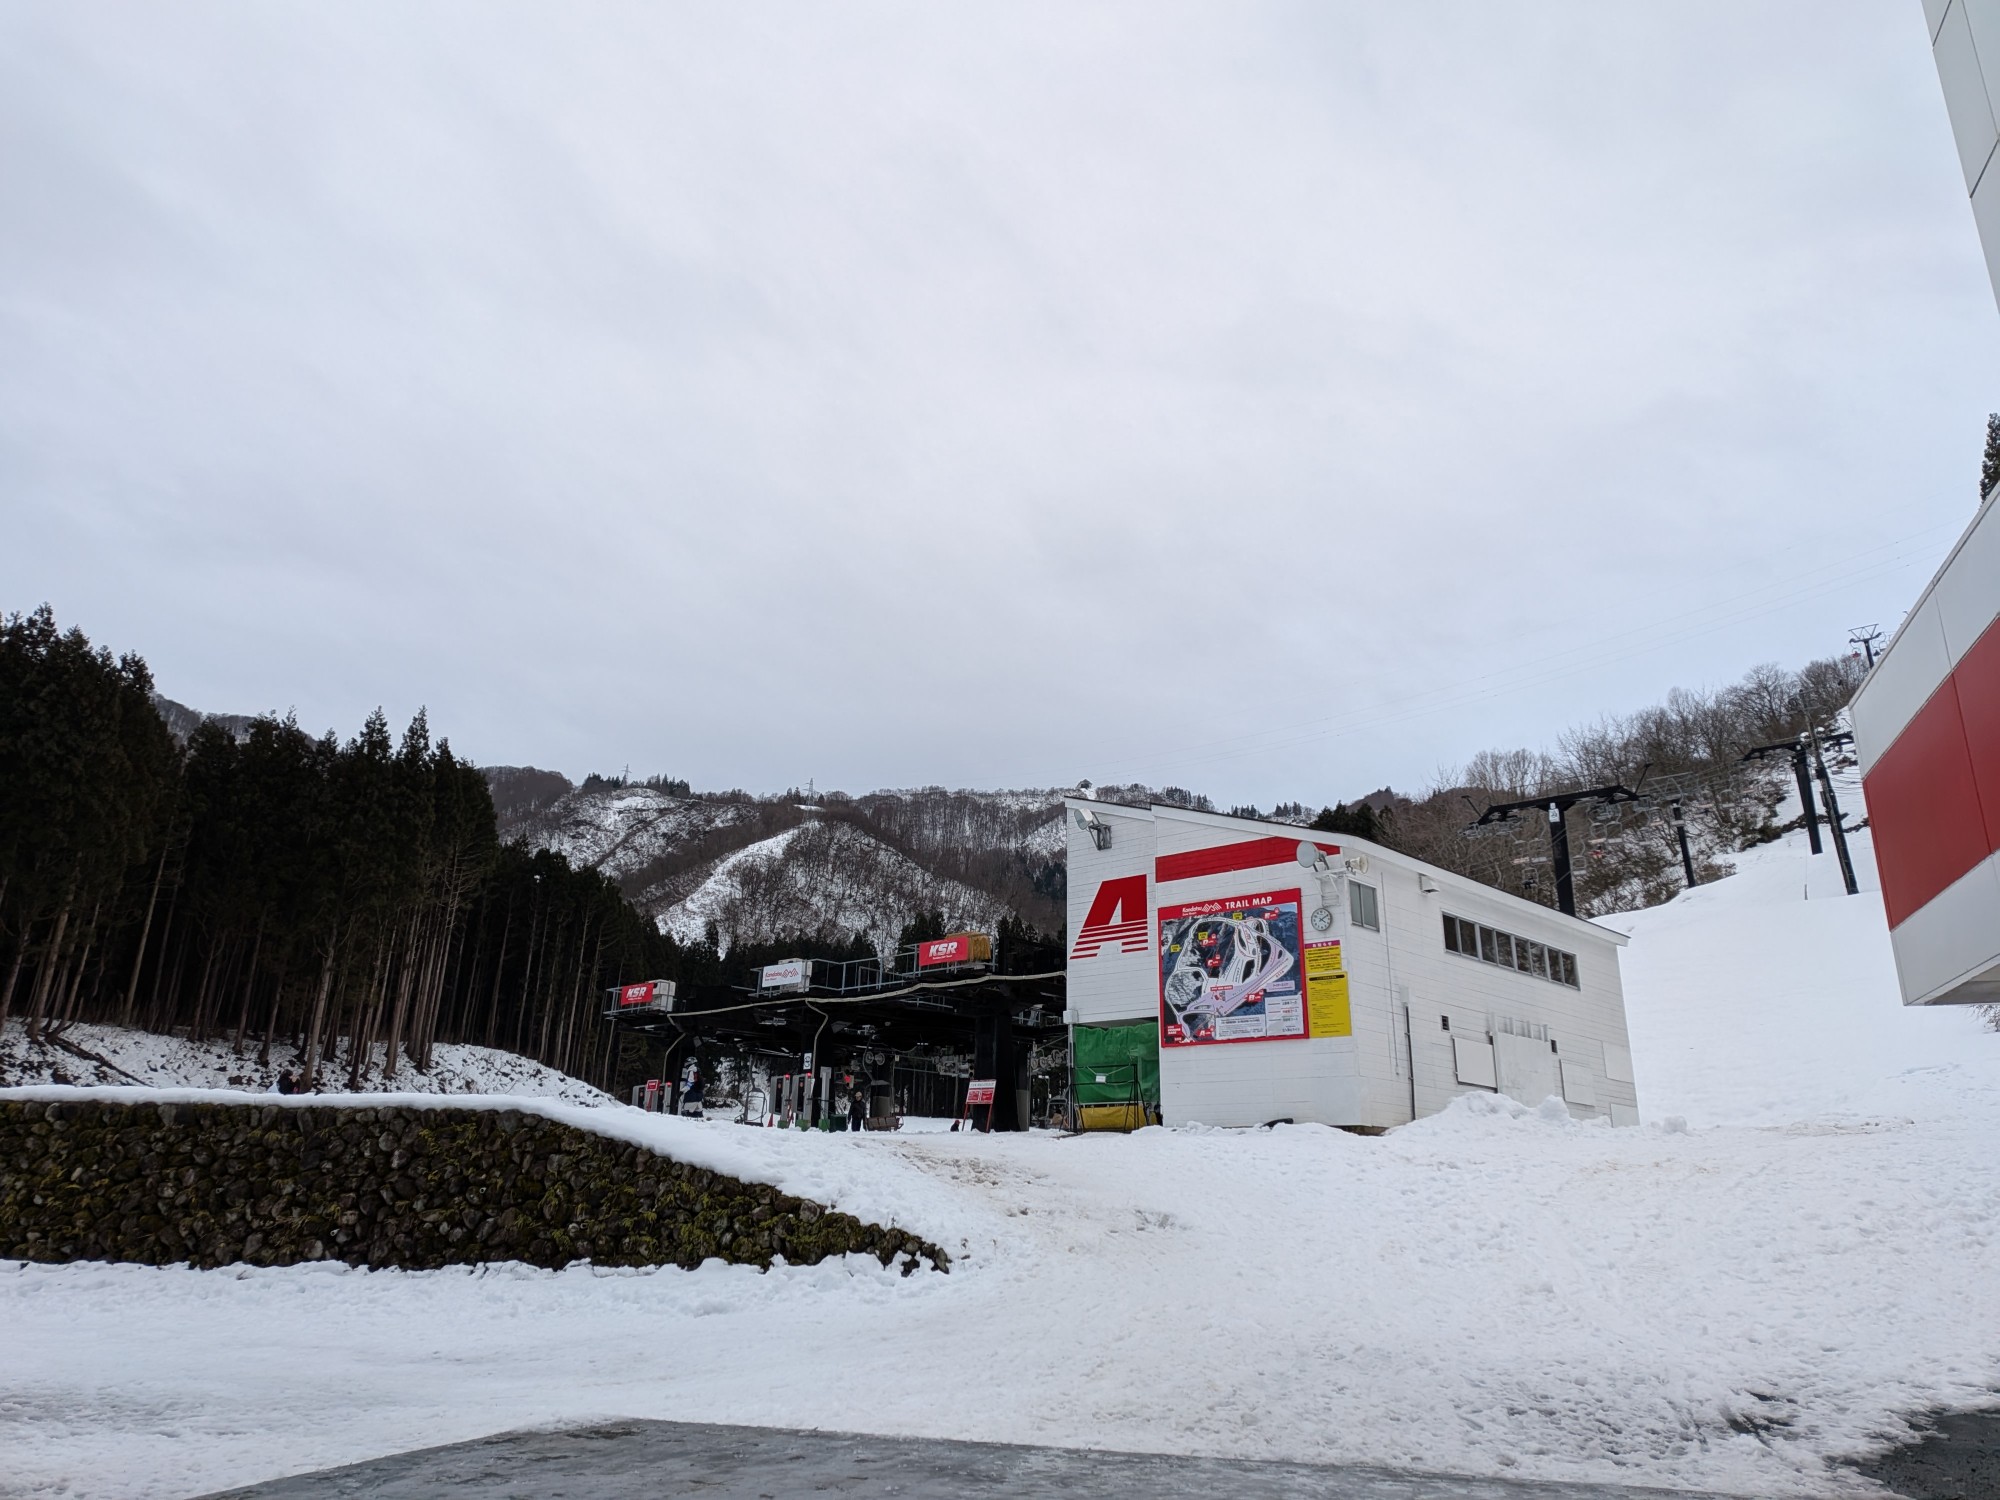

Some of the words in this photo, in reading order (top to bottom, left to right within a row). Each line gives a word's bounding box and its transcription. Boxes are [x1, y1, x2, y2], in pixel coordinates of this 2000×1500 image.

[1225, 900, 1249, 910] TRAIL
[1252, 896, 1272, 906] MAP
[929, 942, 957, 957] KSR
[626, 987, 647, 998] KSR
